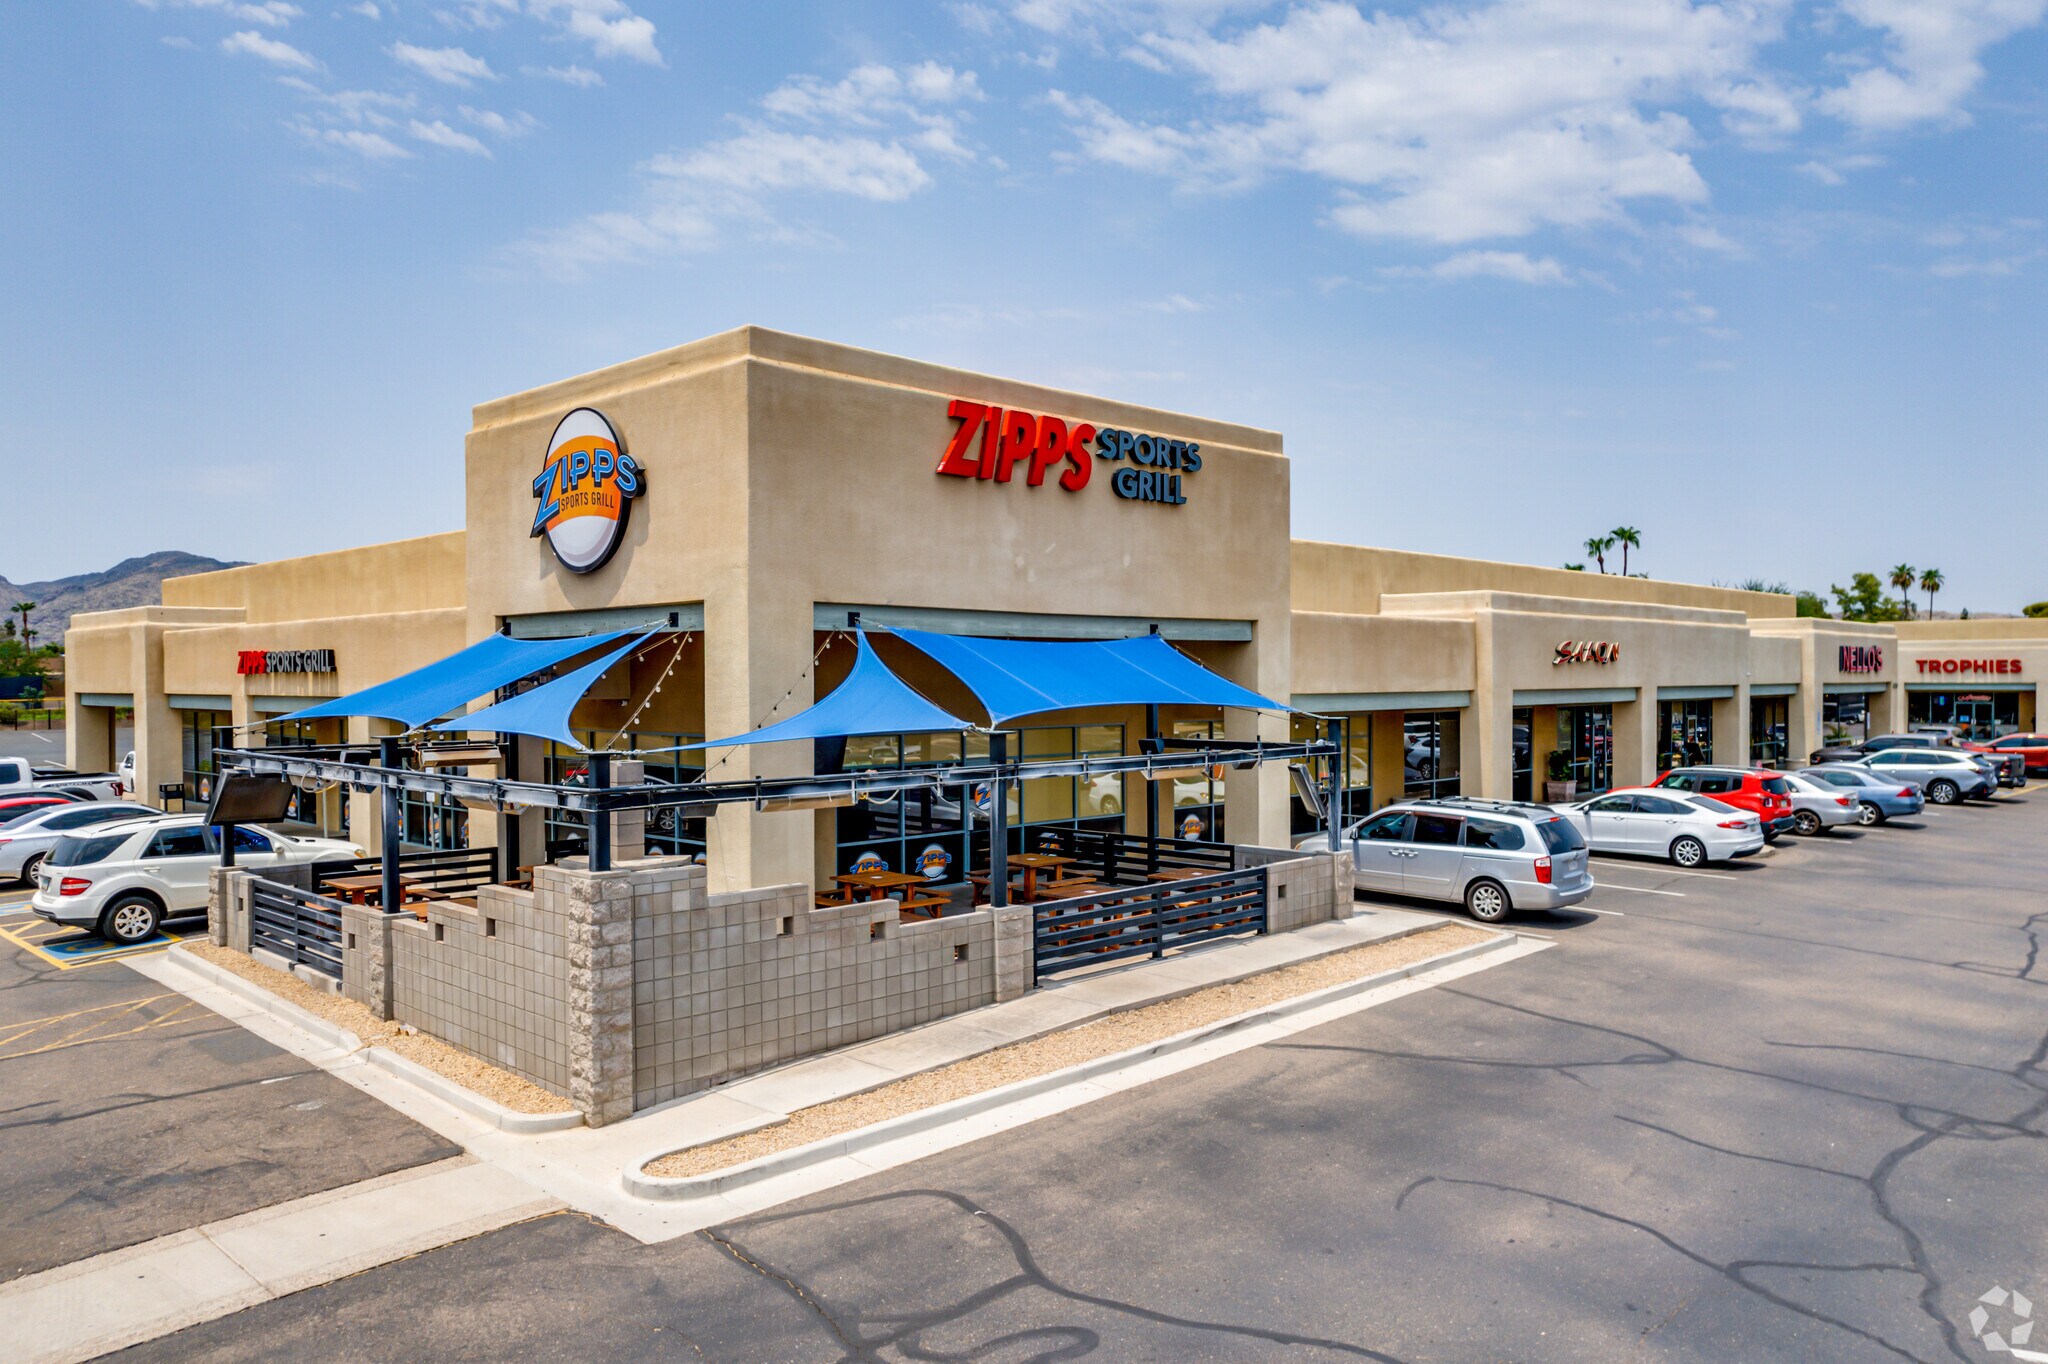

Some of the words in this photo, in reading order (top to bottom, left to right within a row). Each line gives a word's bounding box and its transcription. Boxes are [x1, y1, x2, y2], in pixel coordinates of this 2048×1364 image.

[936, 400, 1096, 492] ZIPPS
[1096, 428, 1202, 473] SPORTS
[531, 448, 641, 538] ZIPPS
[1111, 467, 1187, 505] GRILL
[561, 492, 589, 512] SPORTS
[591, 491, 615, 509] GRILL
[237, 651, 268, 675] ZIPPS
[265, 651, 302, 673] SPORTS
[303, 649, 336, 673] GRILL
[1552, 641, 1620, 664] SALON
[1915, 659, 2023, 674] TROPHIES
[915, 852, 953, 873] ZIPPS
